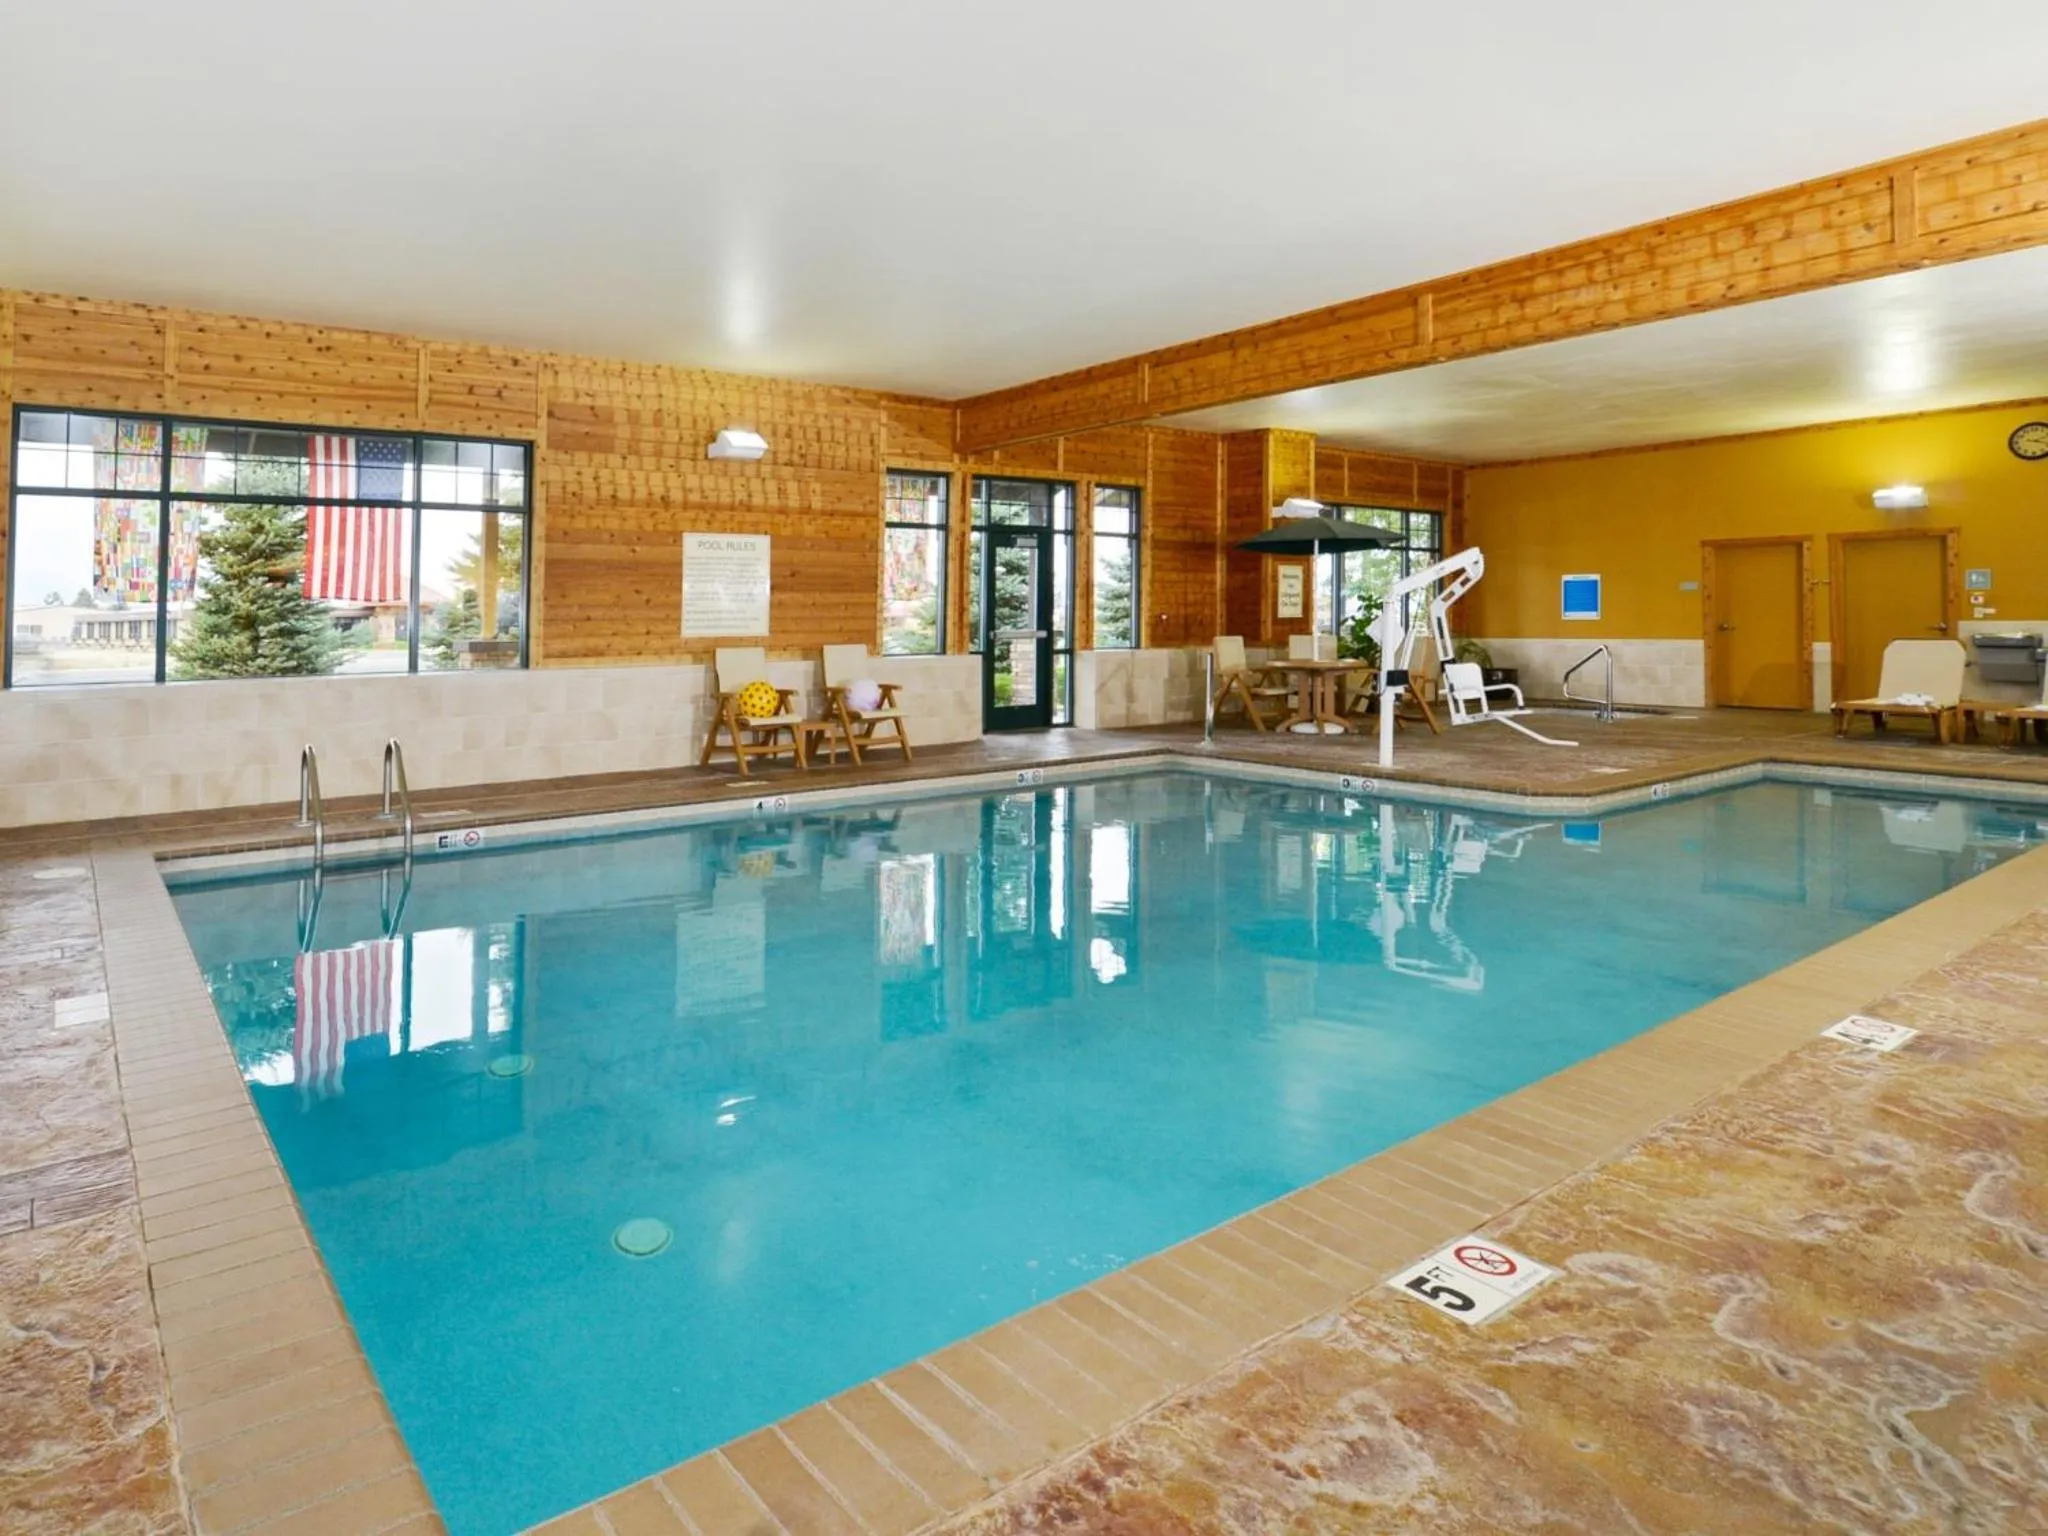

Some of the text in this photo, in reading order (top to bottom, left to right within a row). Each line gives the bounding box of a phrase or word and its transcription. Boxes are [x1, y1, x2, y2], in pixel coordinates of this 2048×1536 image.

[697, 539, 756, 552] POOL RULES
[1405, 1266, 1476, 1311] 5 FT
